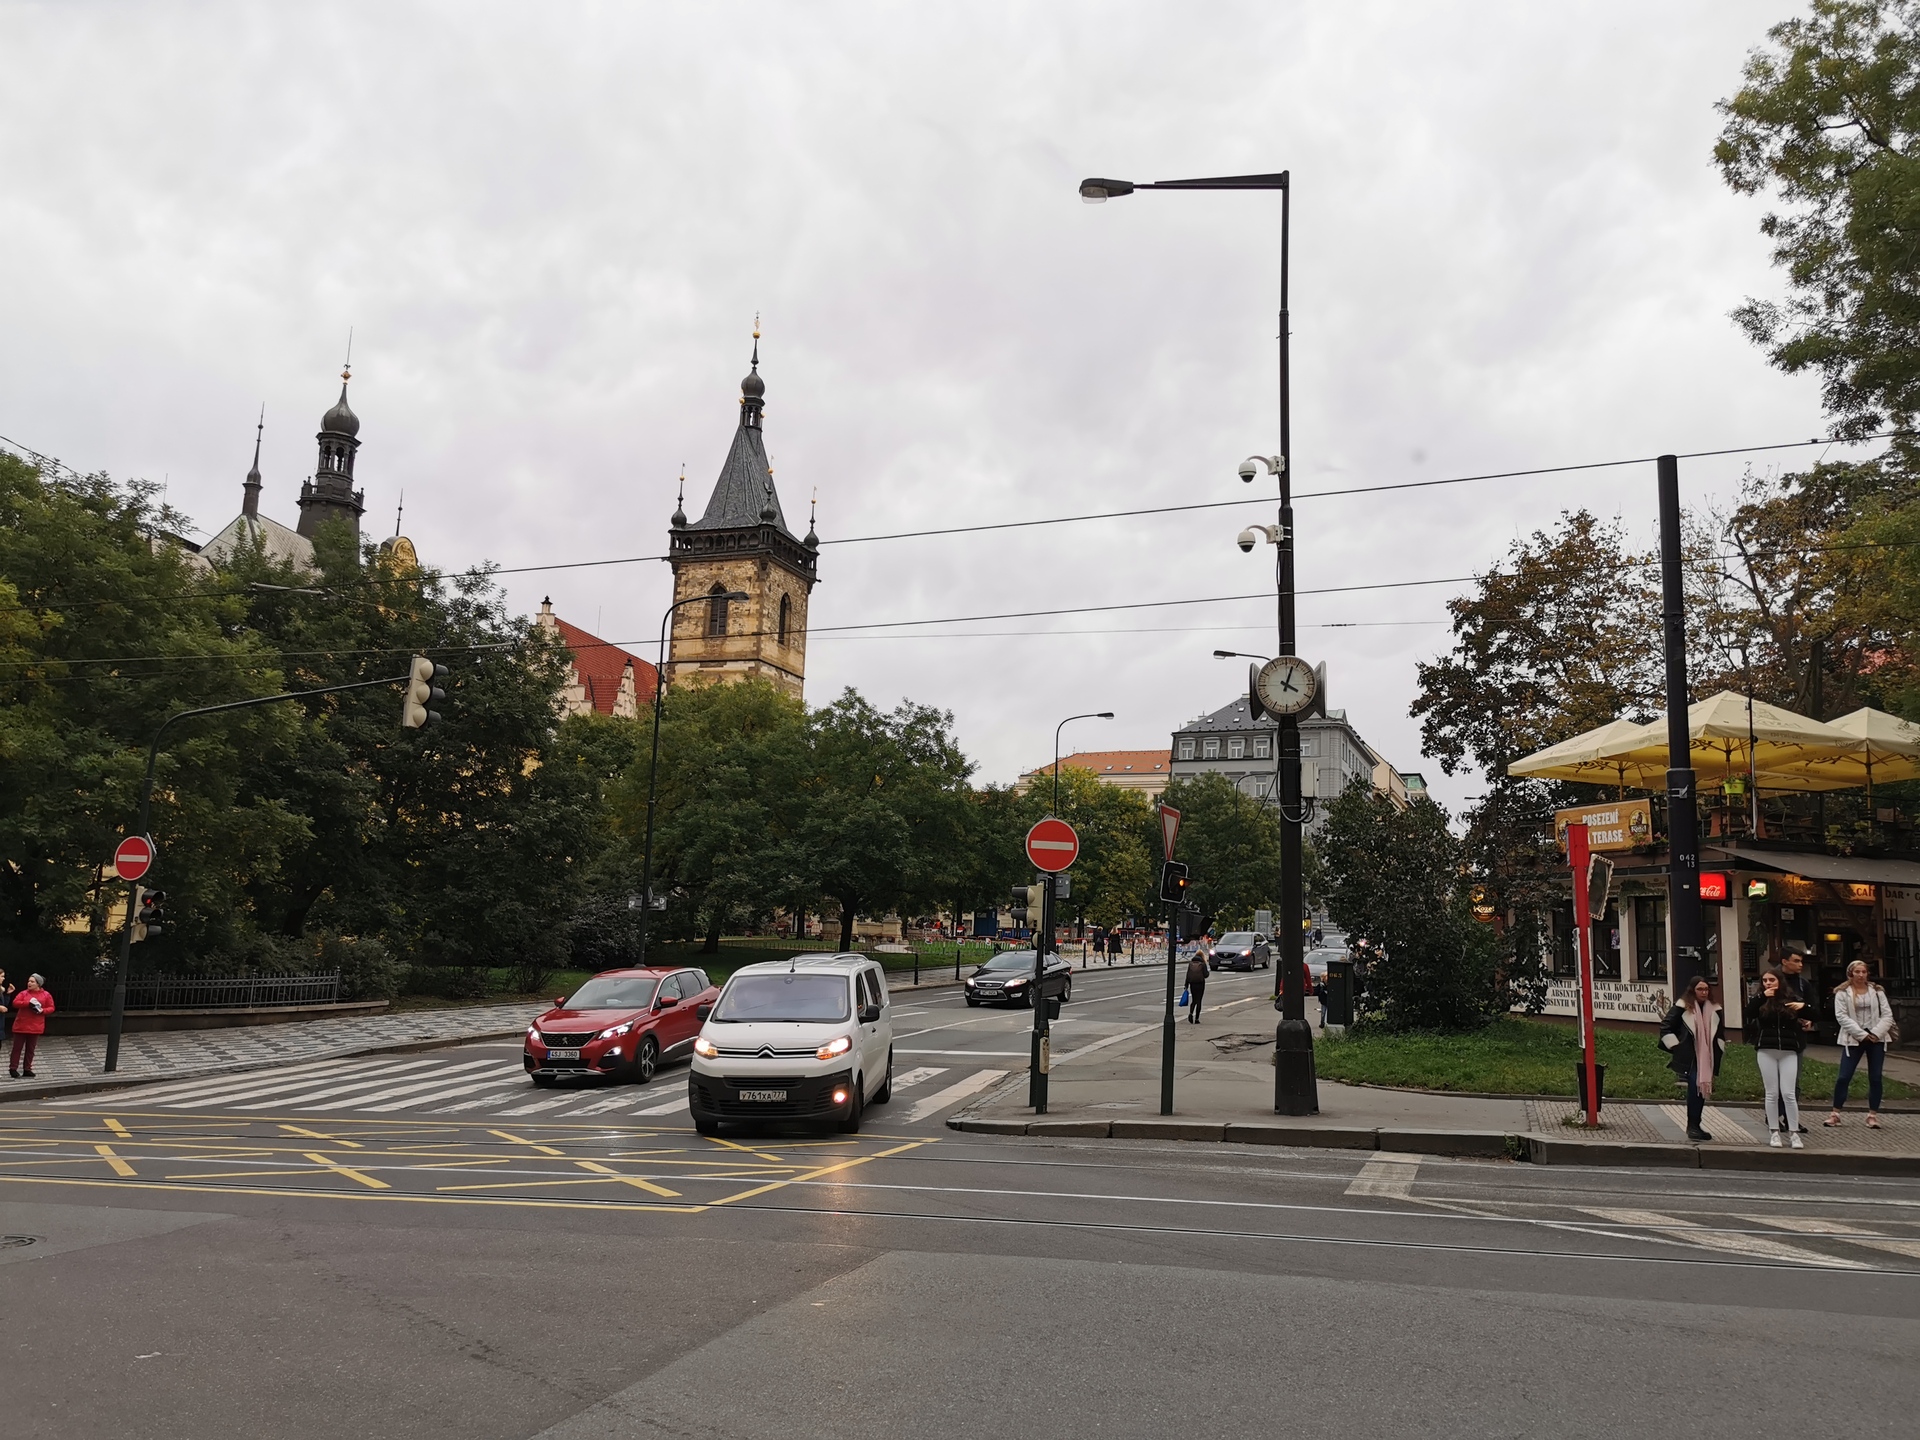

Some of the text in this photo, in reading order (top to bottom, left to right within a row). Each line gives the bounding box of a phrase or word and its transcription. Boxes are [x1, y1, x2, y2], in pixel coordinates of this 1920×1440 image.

[1582, 809, 1619, 826] POSEZENÍ
[1592, 829, 1623, 844] TERASE
[1548, 979, 1571, 988] BSINTH
[1614, 983, 1650, 993] KOKTEJLY
[1603, 993, 1622, 1001] SHOP
[1593, 1002, 1615, 1010] OFFEE
[1617, 1003, 1658, 1013] COCKTAILS
